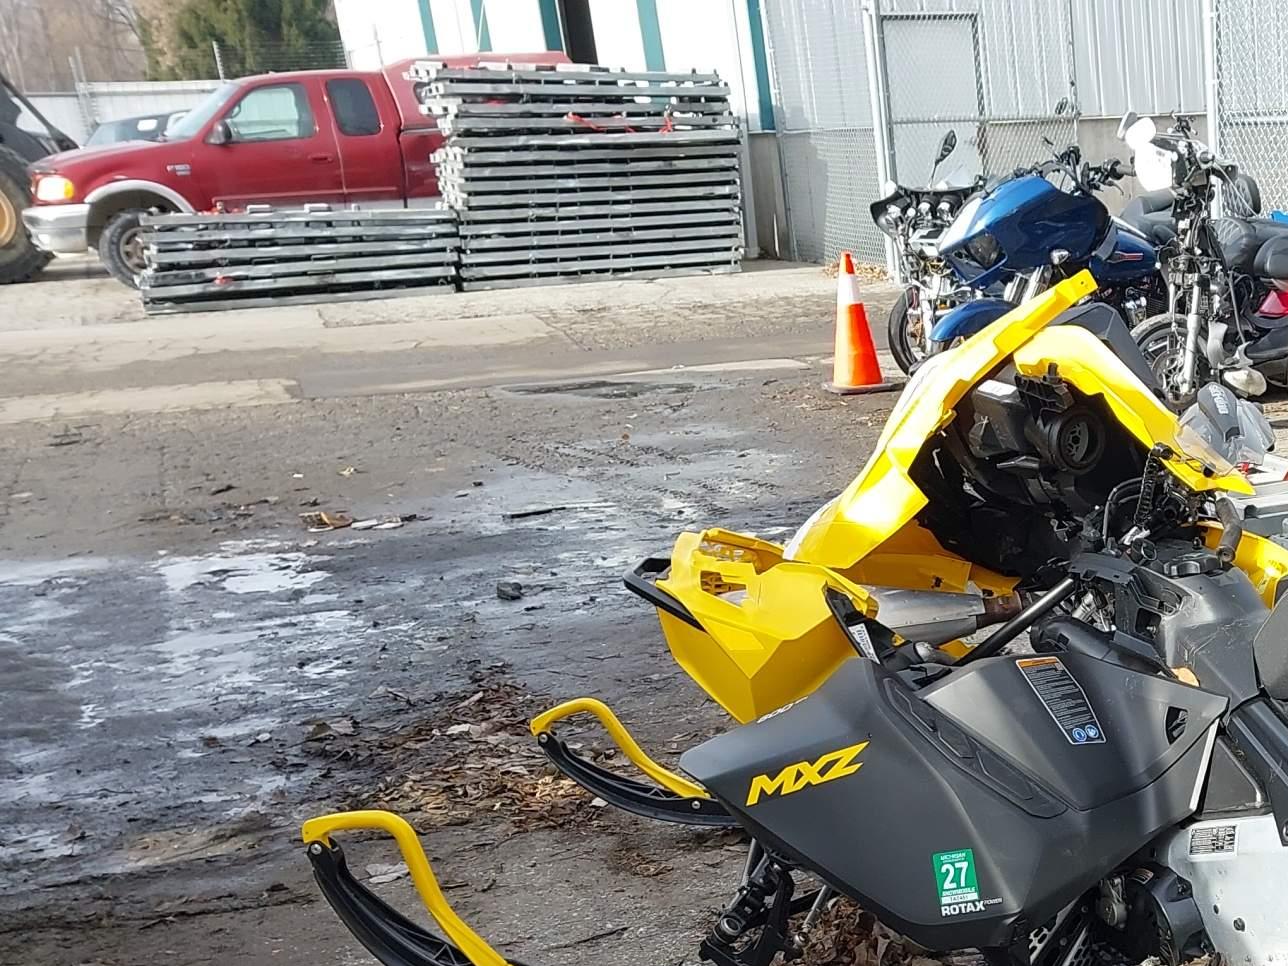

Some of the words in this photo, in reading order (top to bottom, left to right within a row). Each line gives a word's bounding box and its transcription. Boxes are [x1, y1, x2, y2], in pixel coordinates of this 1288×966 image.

[746, 740, 870, 807] MXZ
[941, 861, 968, 890] 27
[941, 900, 986, 917] ROTAX
